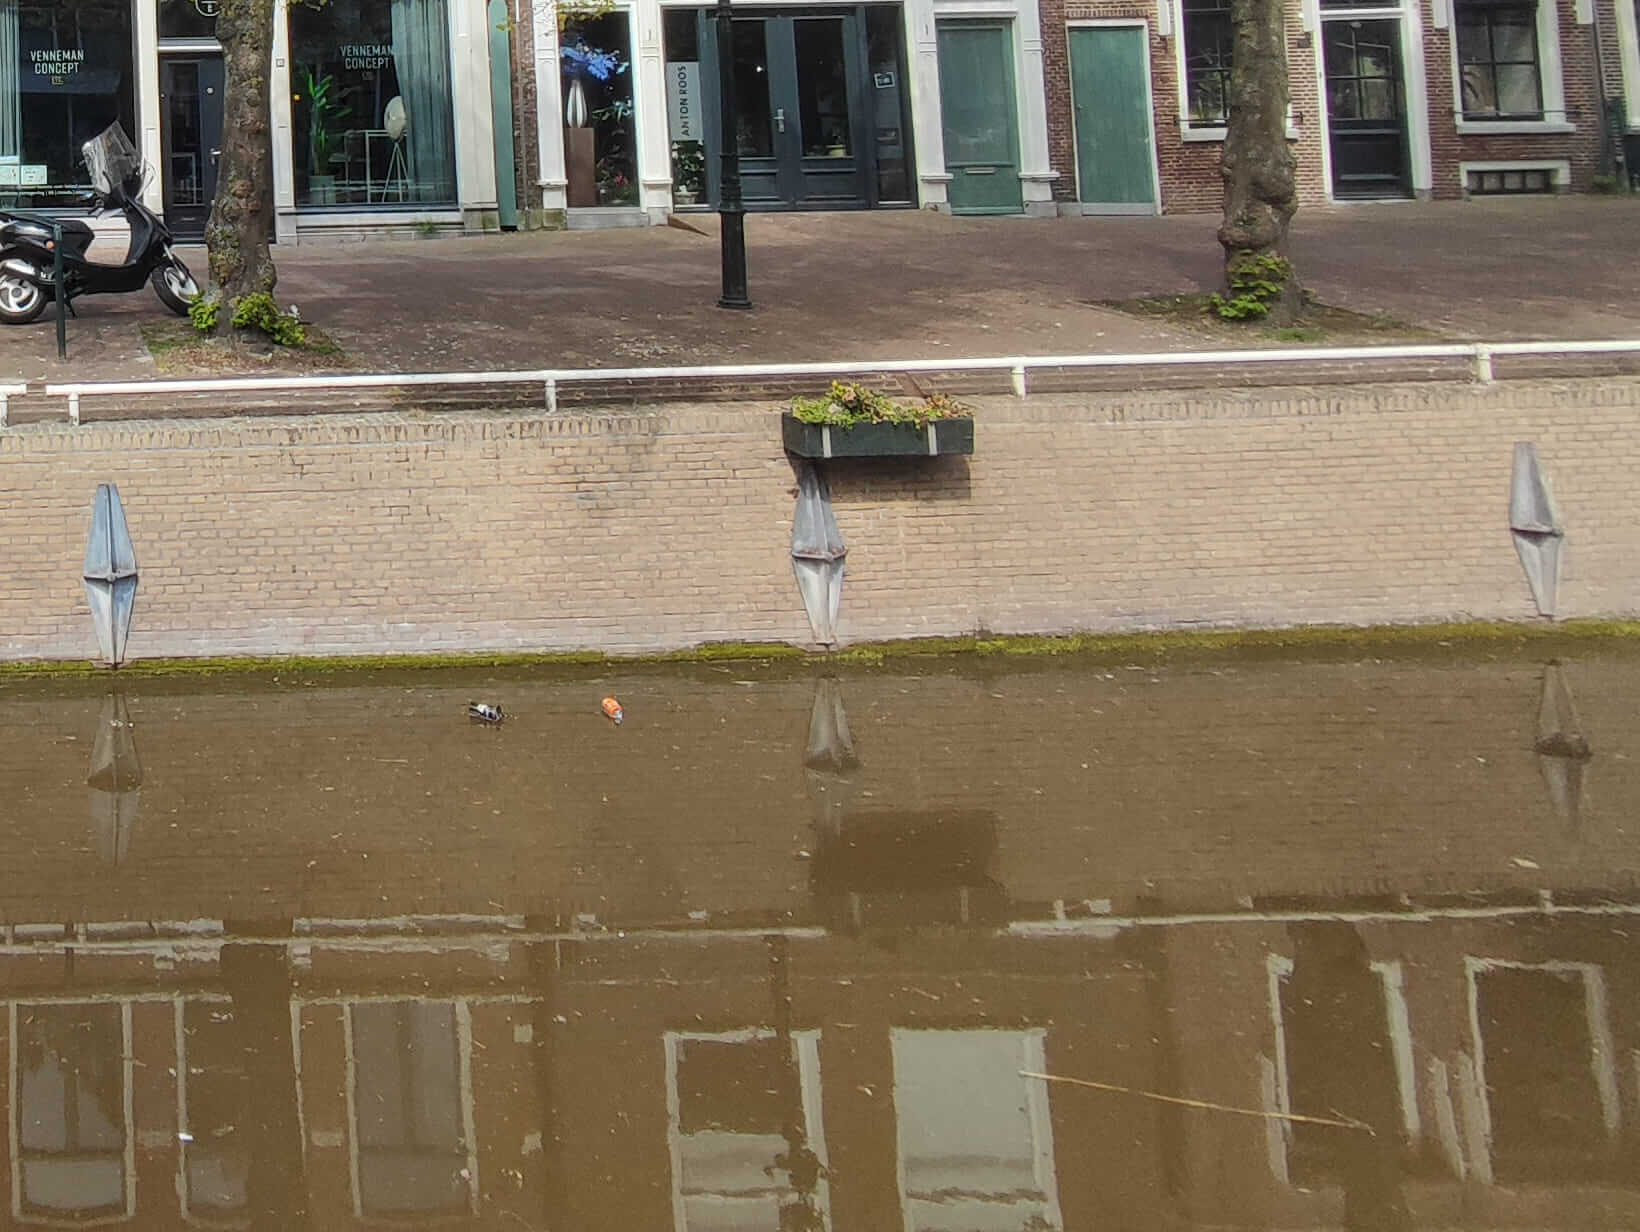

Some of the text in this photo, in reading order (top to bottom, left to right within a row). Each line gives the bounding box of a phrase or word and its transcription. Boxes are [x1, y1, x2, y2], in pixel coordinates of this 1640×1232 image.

[30, 49, 84, 62] VENNEMAN
[340, 44, 394, 57] VENNEMAN
[34, 62, 79, 74] CONCEPT
[345, 57, 389, 70] CONCEPT
[677, 65, 690, 136] ANTON ROOS
